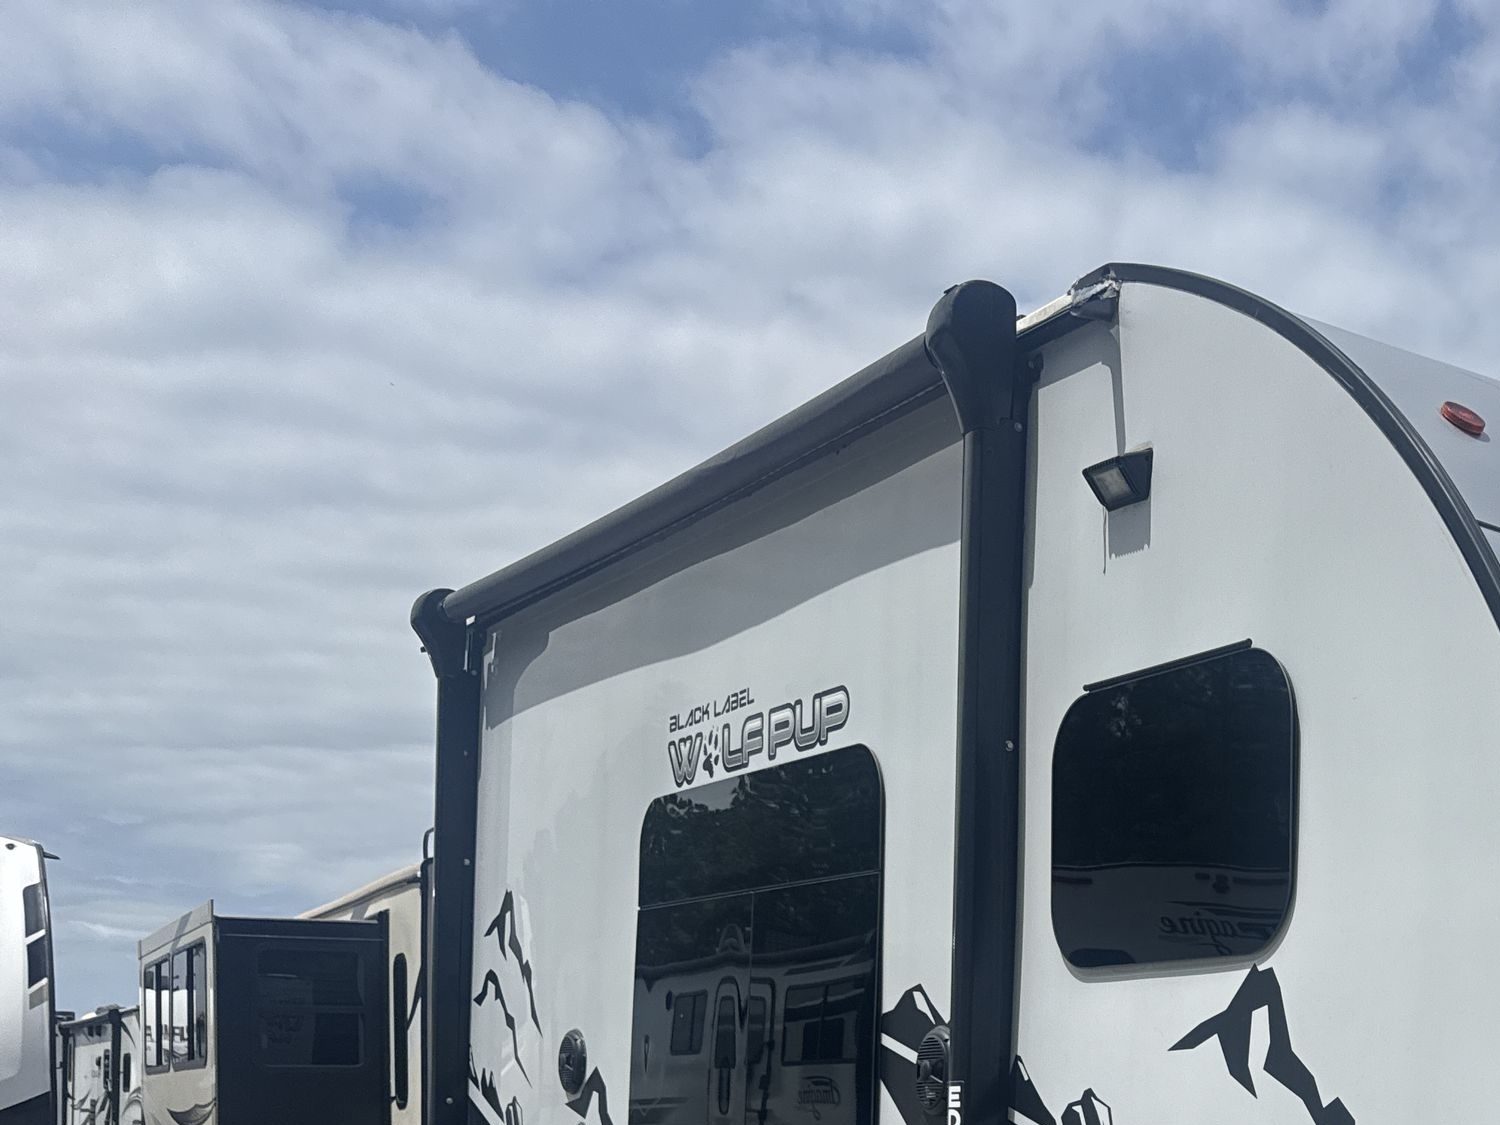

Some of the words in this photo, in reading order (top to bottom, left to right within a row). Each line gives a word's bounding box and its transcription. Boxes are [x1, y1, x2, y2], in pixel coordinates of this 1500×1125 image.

[669, 702, 710, 733] BLACK
[713, 687, 755, 718] LABEL
[768, 685, 850, 761] PUP
